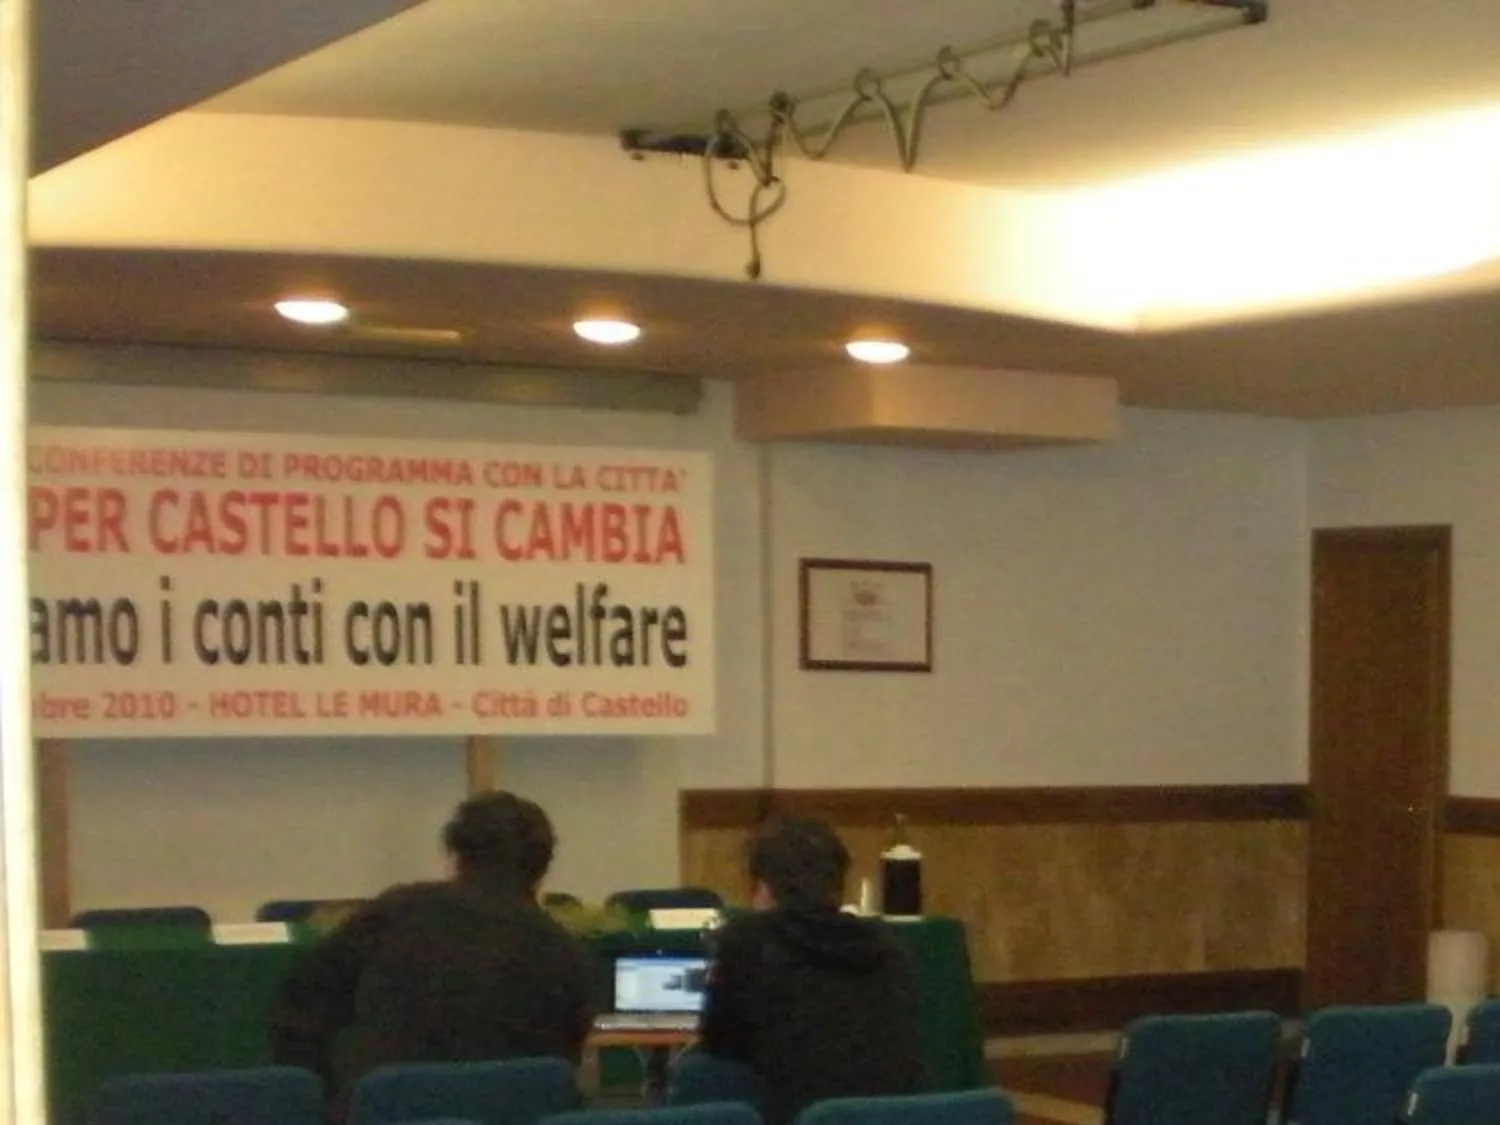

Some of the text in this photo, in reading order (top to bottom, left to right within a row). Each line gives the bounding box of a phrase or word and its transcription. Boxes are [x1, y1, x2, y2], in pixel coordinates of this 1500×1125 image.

[238, 451, 274, 480] DI
[283, 452, 474, 486] PROGRAMMA
[483, 460, 543, 489] CON
[552, 463, 586, 490] LA
[28, 486, 687, 565] PER CASTELLO SI CAMBIA
[159, 574, 173, 665] i
[192, 576, 325, 667] conti
[345, 600, 434, 667] con
[453, 578, 481, 667] il
[499, 580, 688, 668] welfare
[102, 690, 177, 720] 2010
[209, 690, 306, 720] HOTEL
[316, 690, 349, 718] LE
[359, 689, 444, 718] MURA
[545, 689, 572, 718] di
[580, 689, 690, 718] Castello
